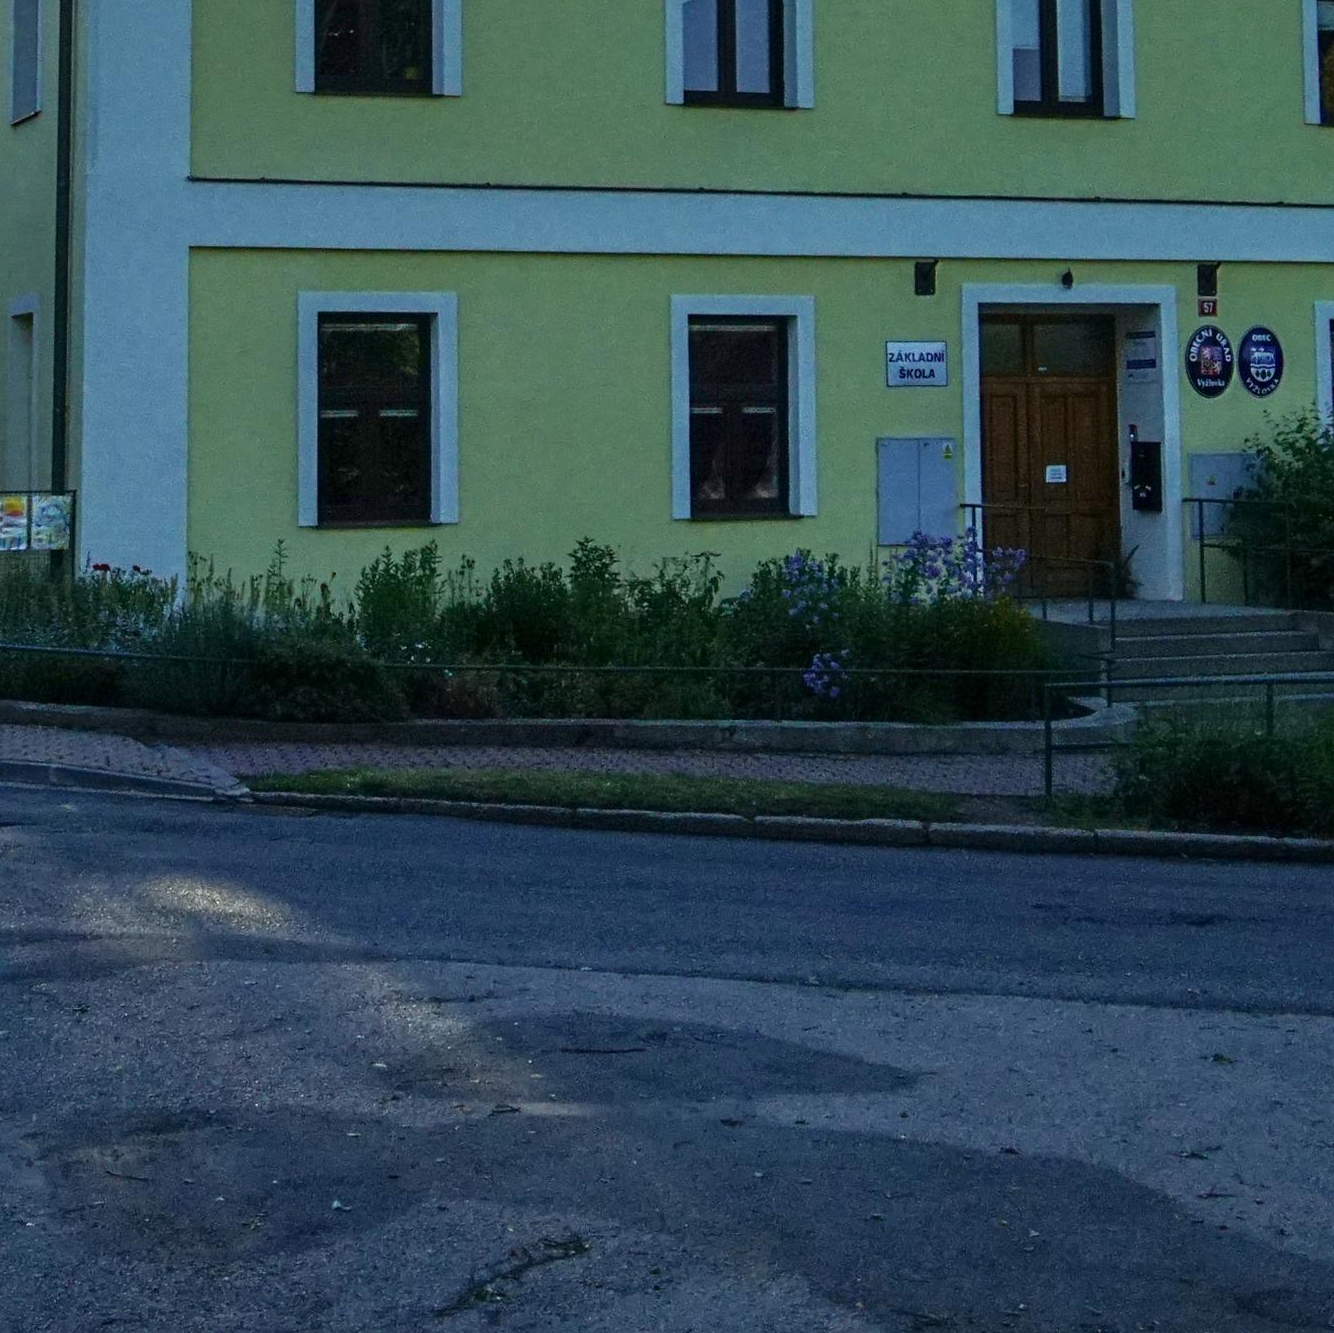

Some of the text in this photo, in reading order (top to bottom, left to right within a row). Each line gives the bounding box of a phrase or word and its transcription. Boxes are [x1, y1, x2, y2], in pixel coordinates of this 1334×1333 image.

[1203, 302, 1214, 314] 57
[1251, 334, 1272, 342] OBEC
[888, 350, 945, 363] ZÁKLADNÍ
[899, 366, 936, 379] ŠKOLA
